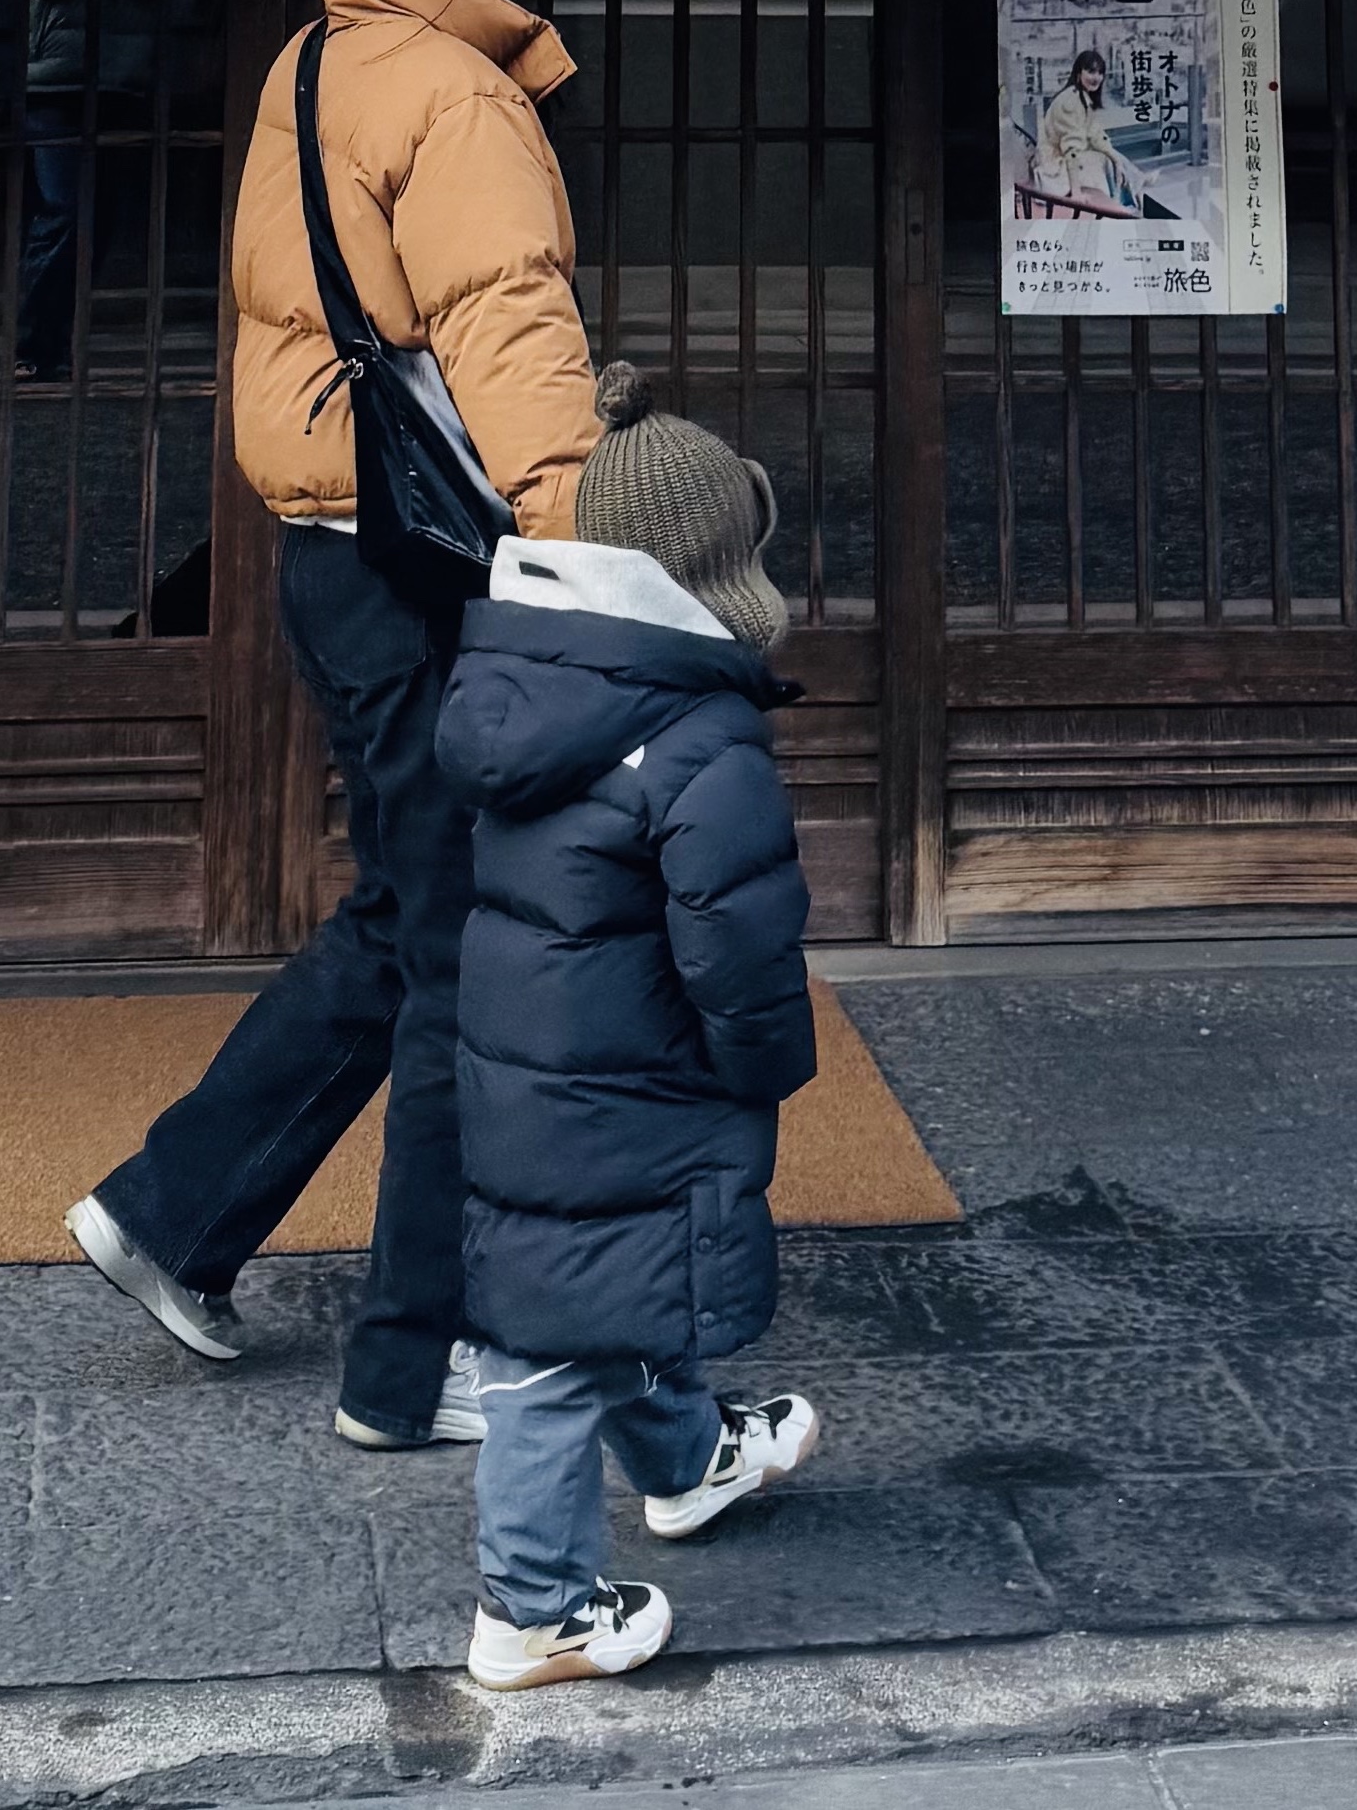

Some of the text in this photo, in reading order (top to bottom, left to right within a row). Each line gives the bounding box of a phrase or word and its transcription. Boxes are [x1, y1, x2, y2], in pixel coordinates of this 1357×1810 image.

[1130, 50, 1154, 123] 街歩き
[1158, 49, 1181, 145] オトナの
[1015, 239, 1070, 253] 旅色なら、
[1016, 260, 1104, 274] 行きたい場所が
[1018, 280, 1111, 294] きっと見つかる。
[1163, 267, 1213, 293] 旅色
